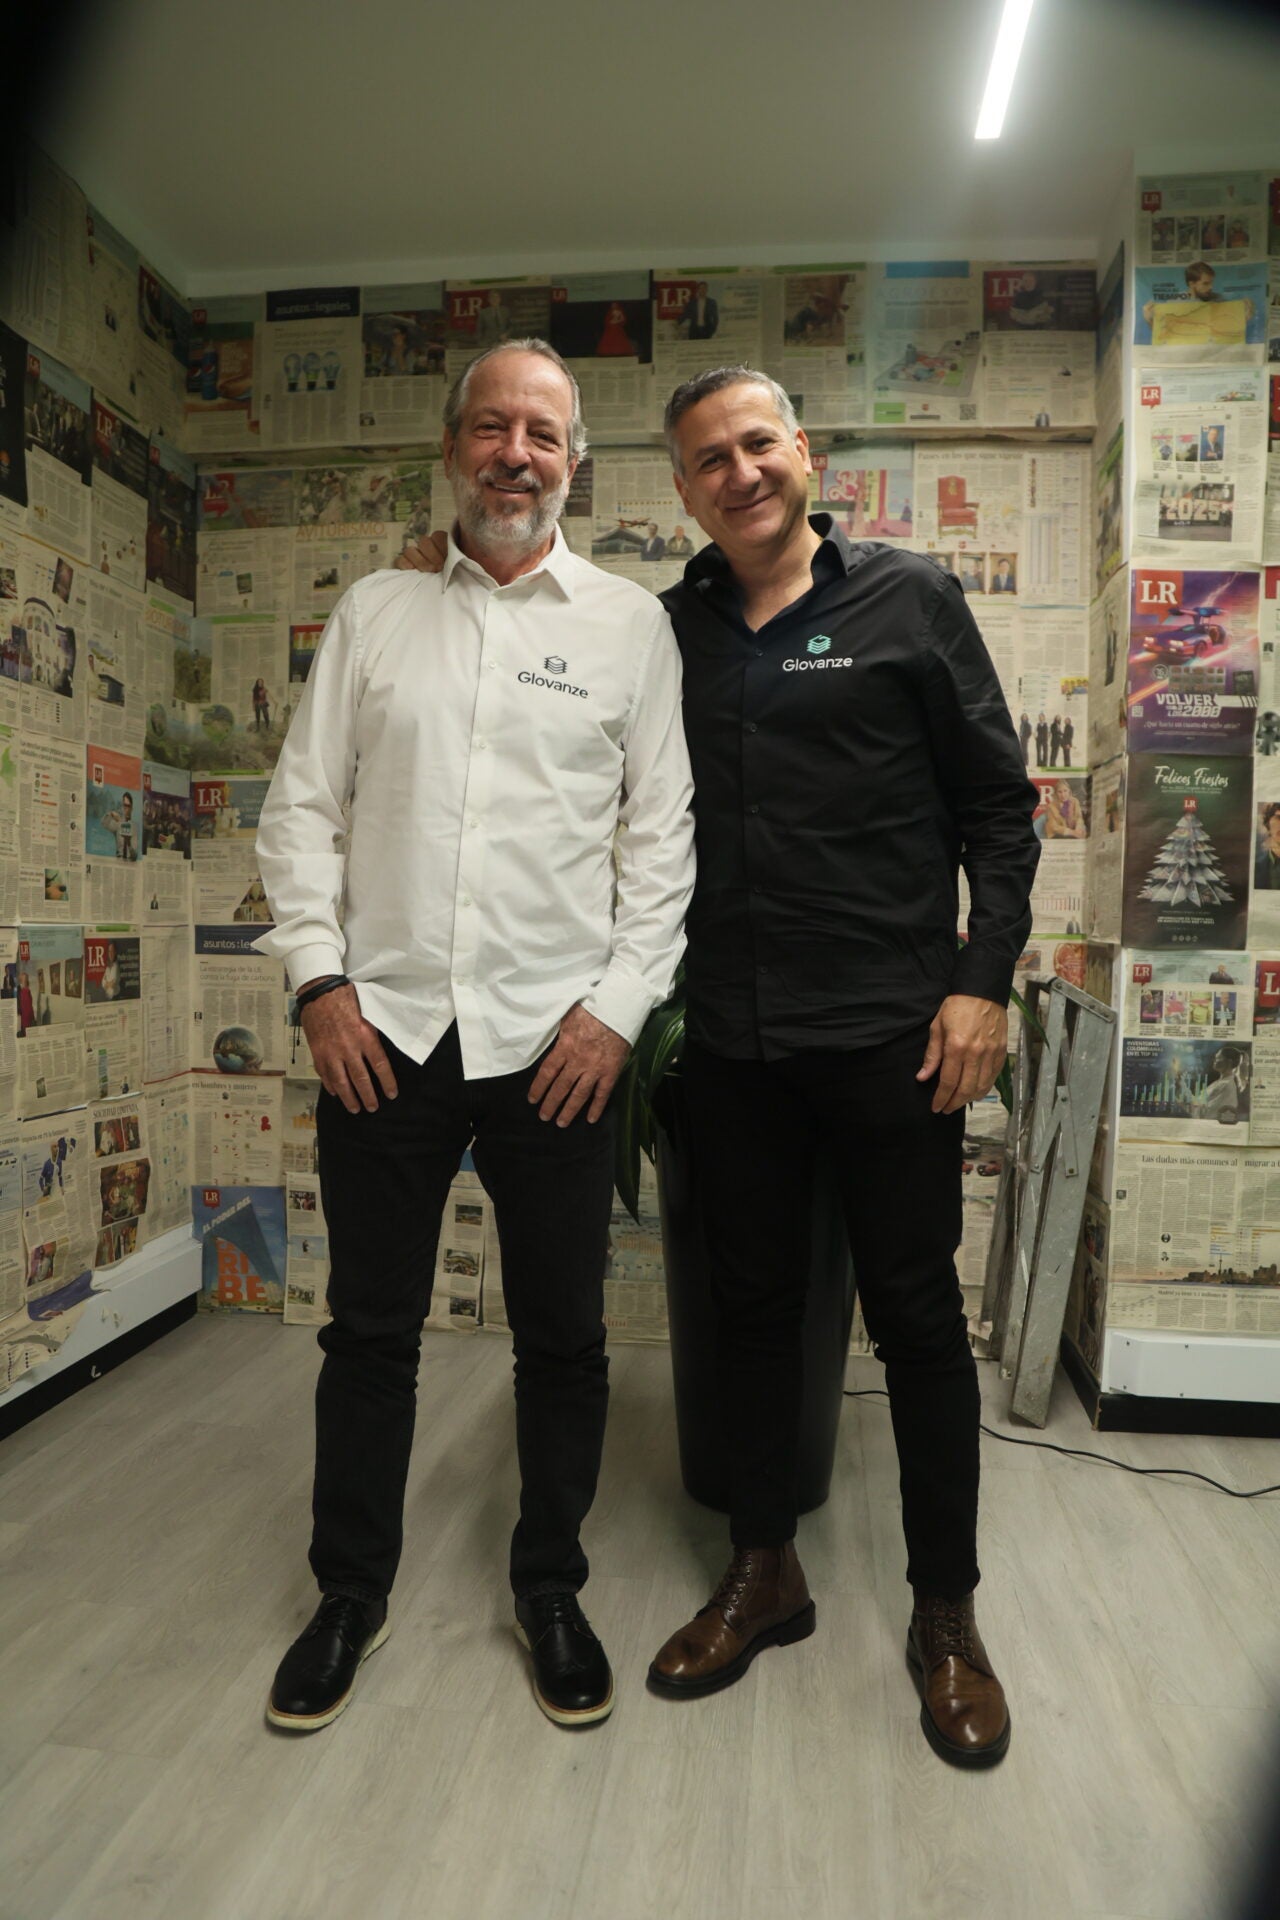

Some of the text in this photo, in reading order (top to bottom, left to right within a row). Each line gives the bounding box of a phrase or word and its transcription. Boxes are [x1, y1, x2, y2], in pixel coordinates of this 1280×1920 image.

[661, 287, 692, 308] LR
[454, 297, 483, 318] LR
[1142, 388, 1160, 400] LR
[97, 411, 113, 437] LR
[812, 457, 827, 467] LR
[1166, 498, 1220, 520] 2025
[295, 522, 386, 539] AVITURISMO
[1140, 579, 1178, 605] LR
[782, 656, 853, 672] Glovanze
[517, 671, 589, 699] Glovanze
[1155, 693, 1213, 706] VOLVER
[1183, 705, 1222, 718] 2000
[1154, 765, 1229, 787] Felices Fiestas
[197, 787, 224, 807] LR
[1184, 799, 1197, 808] LR
[20, 944, 30, 955] LR
[87, 946, 105, 967] LR
[1134, 967, 1150, 977] LR
[1142, 1154, 1154, 1163] Las
[1155, 1155, 1178, 1164] dudas
[1196, 1159, 1229, 1167] comunes
[1230, 1158, 1238, 1166] al
[1244, 1159, 1271, 1168] migrar
[205, 1192, 219, 1201] LR
[218, 1276, 267, 1303] BE
